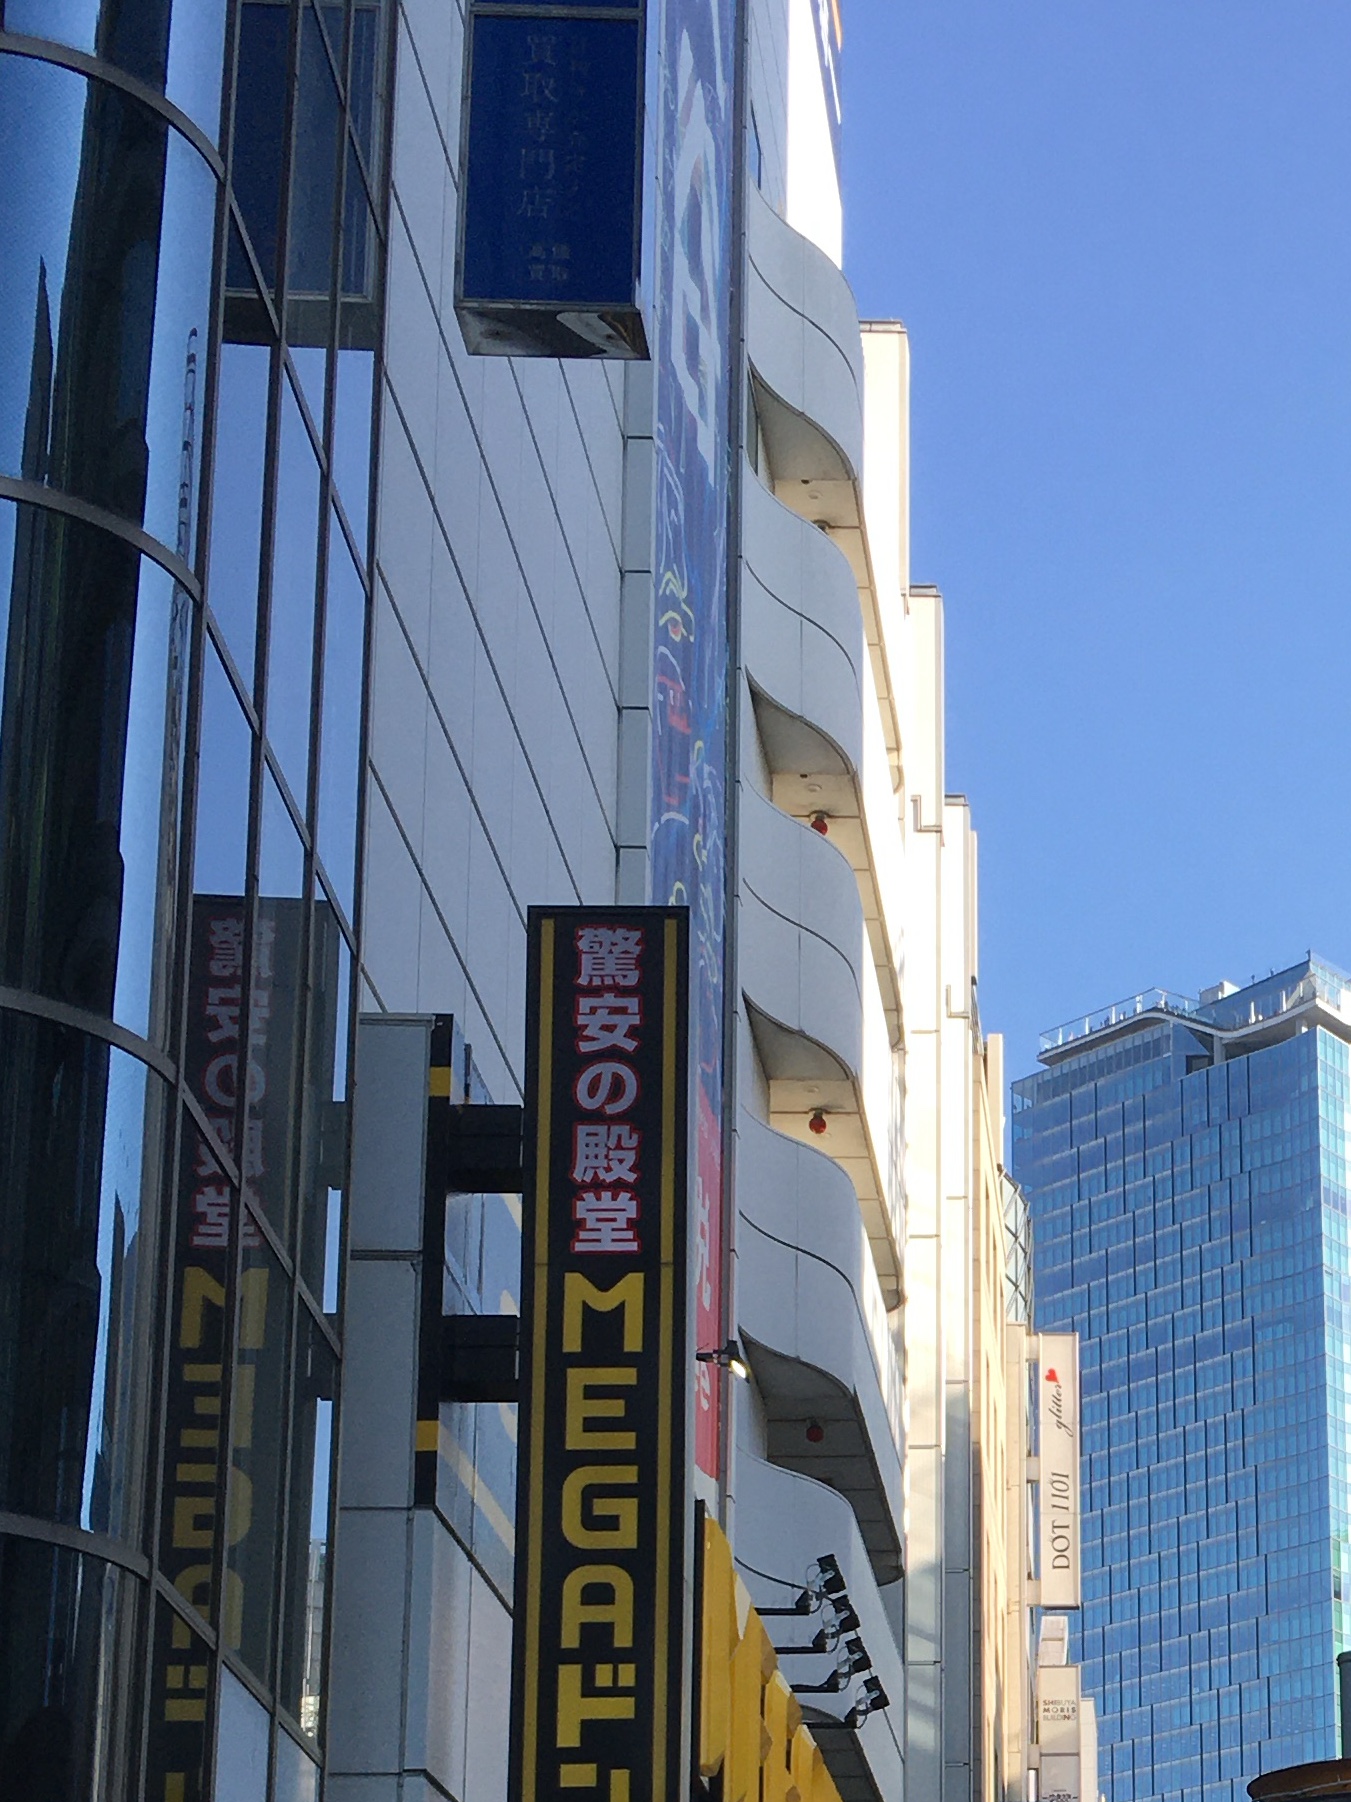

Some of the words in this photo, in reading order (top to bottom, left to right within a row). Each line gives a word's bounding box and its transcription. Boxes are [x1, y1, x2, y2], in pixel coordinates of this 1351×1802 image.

[573, 927, 643, 1253] 驚安の殿堂
[1052, 1520, 1070, 1570] DOT
